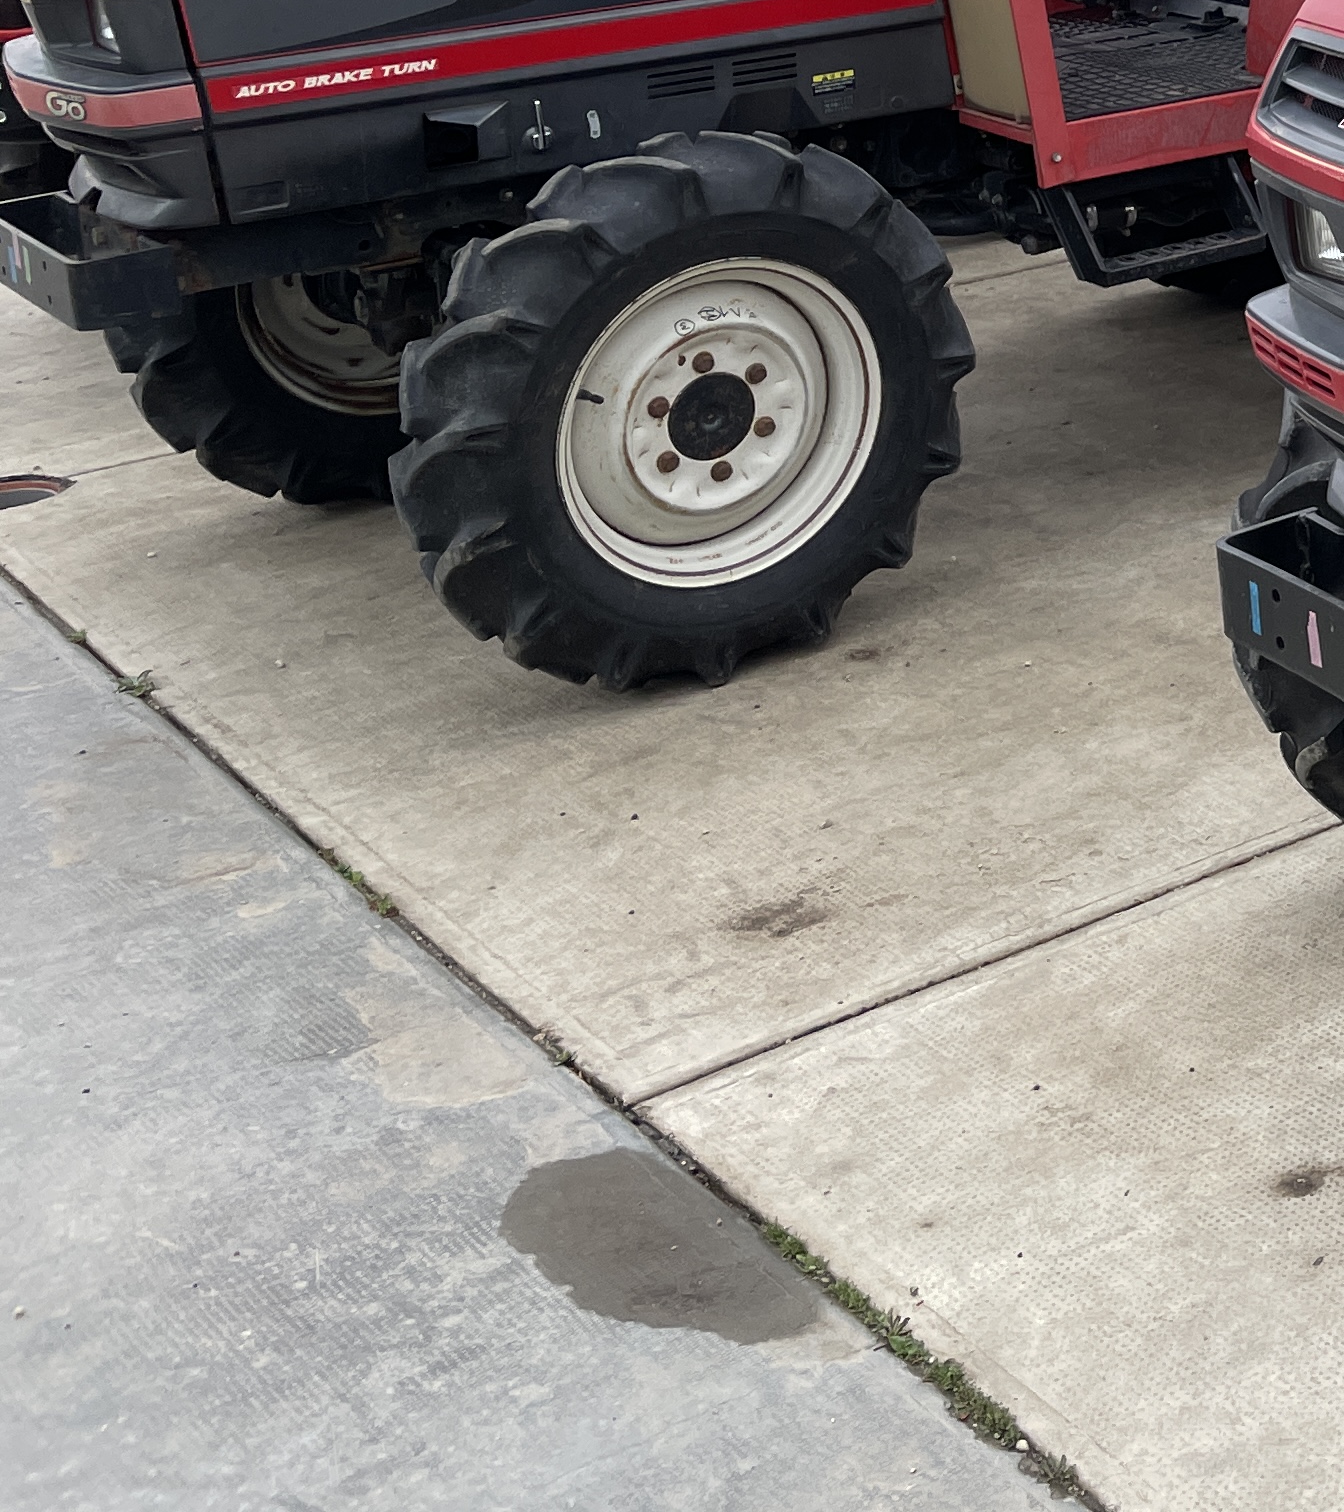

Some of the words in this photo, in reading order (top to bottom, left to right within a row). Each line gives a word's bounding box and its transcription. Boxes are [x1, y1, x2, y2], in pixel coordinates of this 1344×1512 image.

[235, 80, 297, 98] AUTO
[303, 67, 374, 90] BRAKE
[381, 58, 438, 78] TURN
